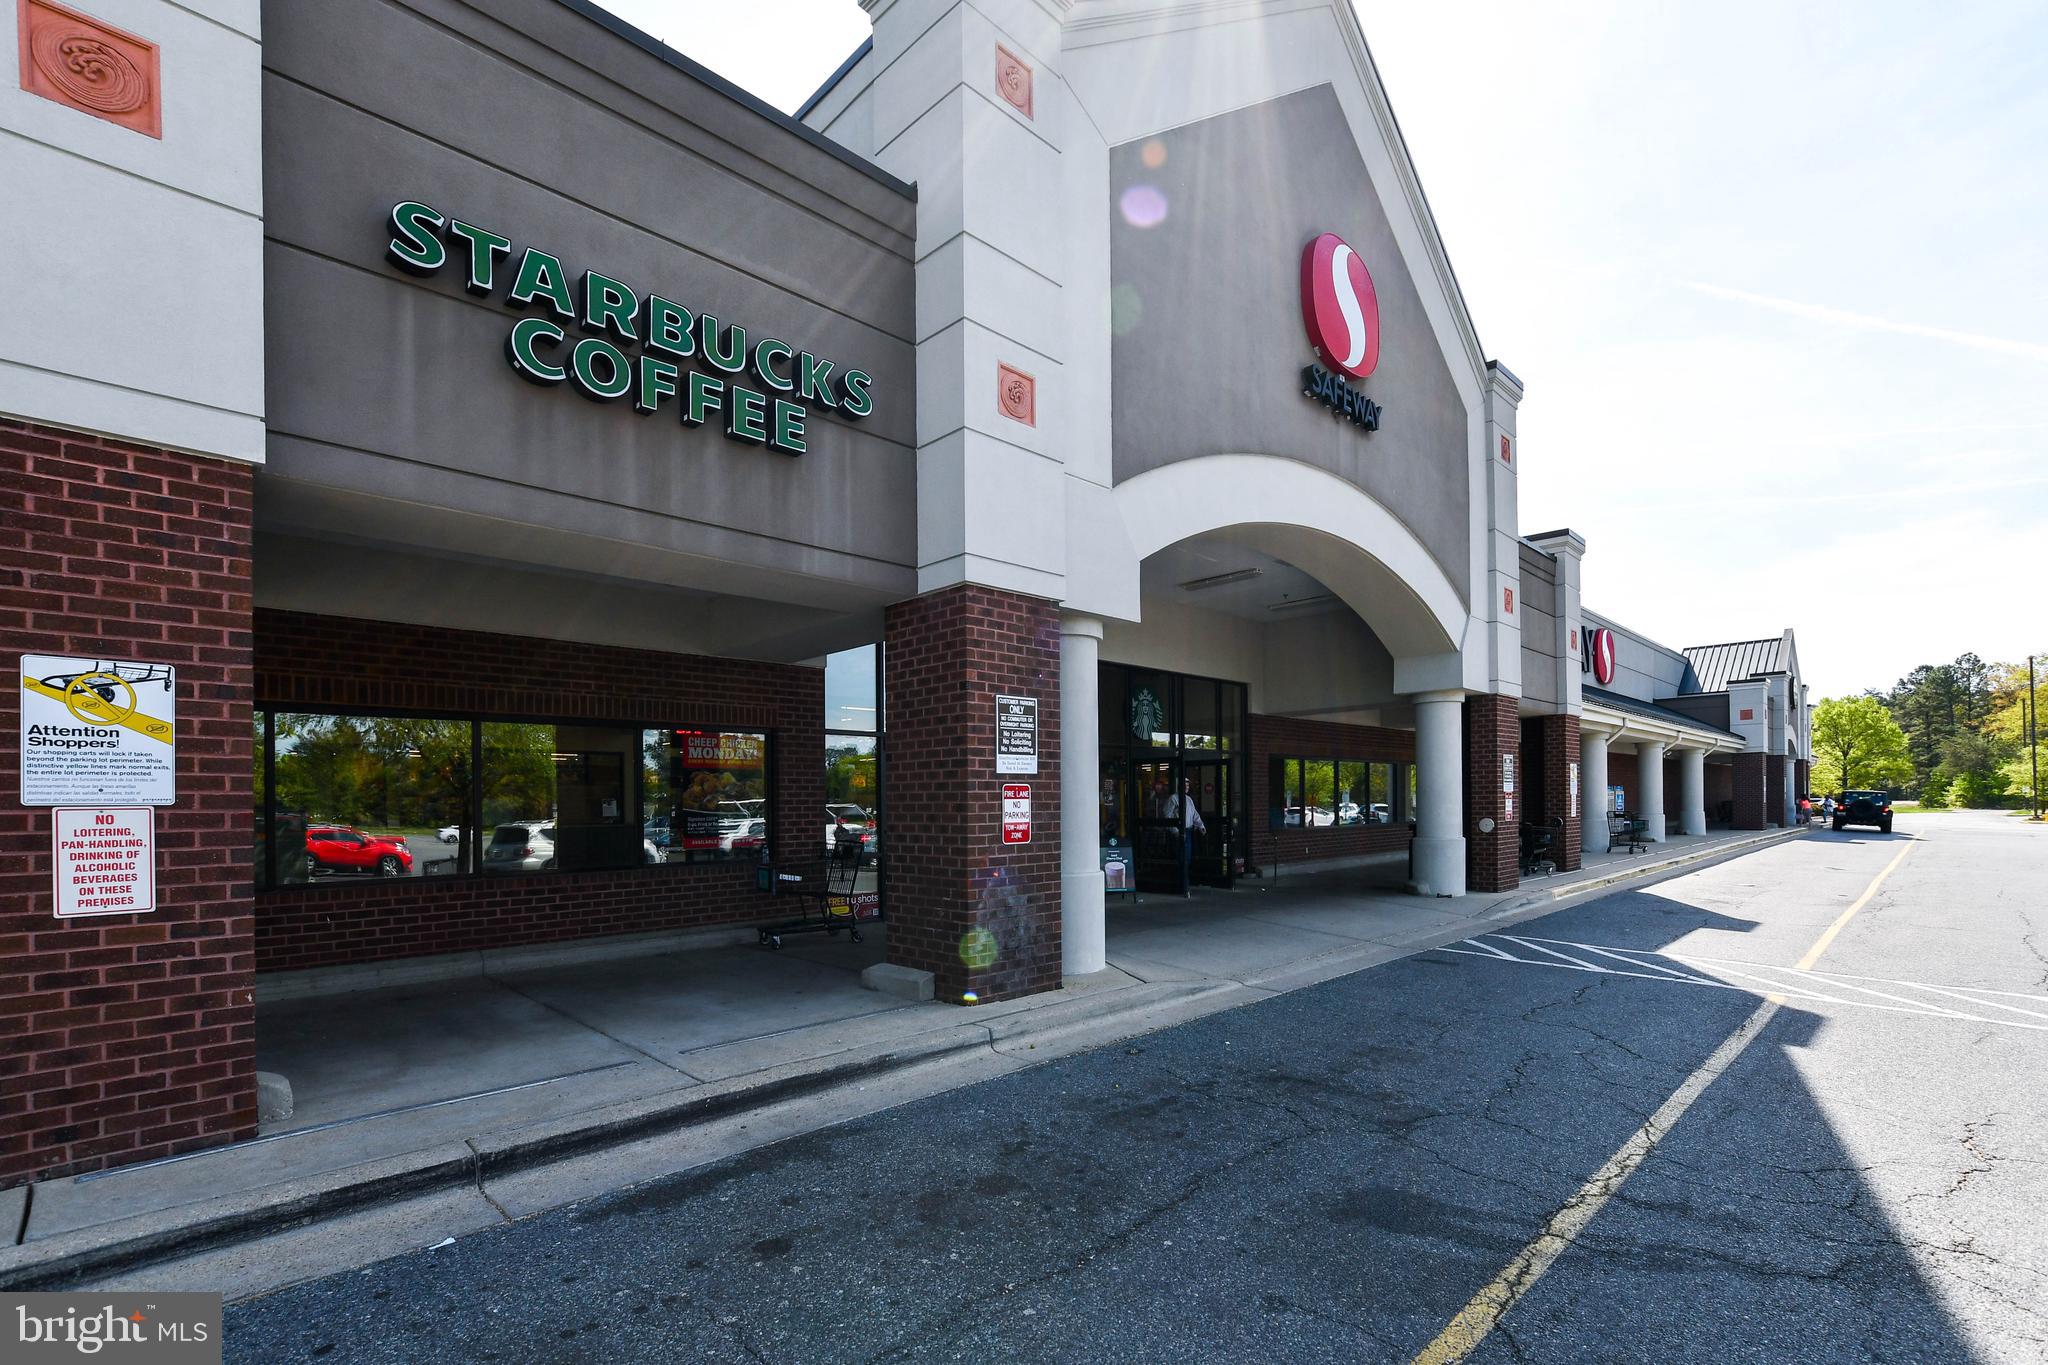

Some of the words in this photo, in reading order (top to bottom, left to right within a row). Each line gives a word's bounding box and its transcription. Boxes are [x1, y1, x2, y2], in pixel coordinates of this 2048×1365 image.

[387, 200, 874, 420] STARBUCKS
[507, 317, 808, 457] COFFEE
[1305, 363, 1383, 430] SAFEWAY
[1009, 705, 1025, 714] ONLY
[28, 725, 120, 738] Attention
[1011, 731, 1032, 739] Loitering
[28, 737, 120, 749] Shoppers!
[688, 737, 718, 747] CHEEP
[1011, 738, 1032, 747] Soliciting
[1004, 790, 1015, 798] FIRE
[1016, 790, 1029, 798] LANE
[1012, 801, 1021, 809] NO
[95, 814, 114, 825] NO
[1005, 811, 1029, 819] PARKING
[1005, 823, 1028, 831] TOW-AWAY
[73, 828, 135, 837] LOITERING,
[1010, 831, 1023, 839] ZONE
[61, 839, 147, 849] PAN-HANDLING,
[69, 851, 123, 861] DRINKING
[126, 850, 140, 859] OF
[74, 862, 136, 872] ALCOHOLIC
[72, 873, 138, 884] BEVERAGES
[79, 887, 94, 896] ON
[97, 885, 132, 895] THESE
[77, 897, 134, 907] PREMISES
[829, 897, 845, 906] FREE
[858, 894, 879, 903] shots
